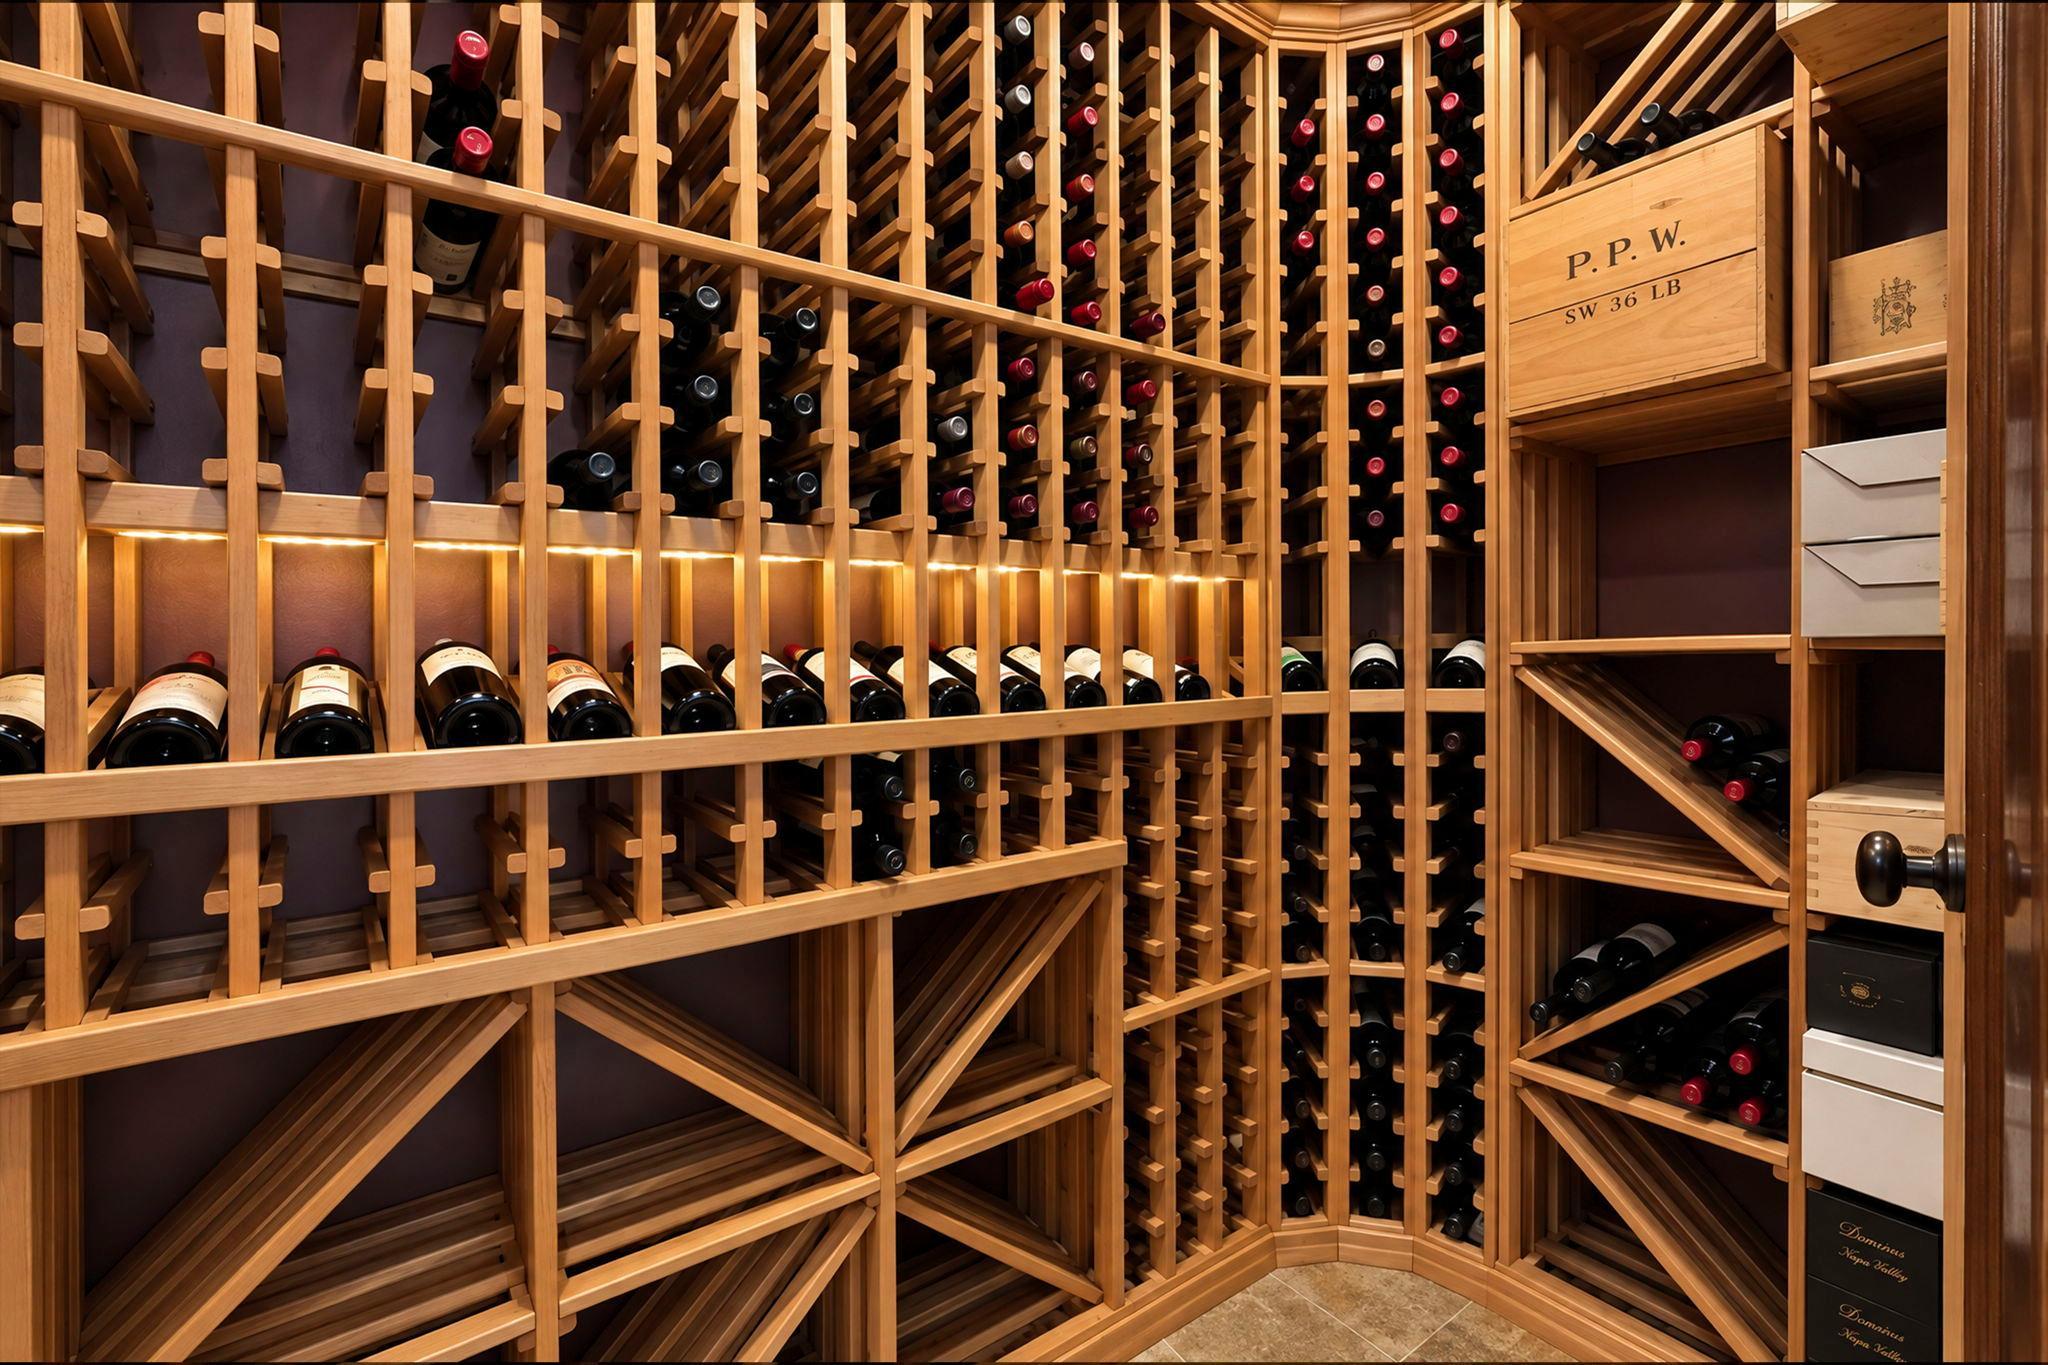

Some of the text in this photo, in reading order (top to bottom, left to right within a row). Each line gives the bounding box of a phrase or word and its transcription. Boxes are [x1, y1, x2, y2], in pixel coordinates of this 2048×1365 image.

[1565, 278, 1682, 325] SW 36 LB
[1839, 1220, 1905, 1259] Dominus
[1838, 1246, 1908, 1283] Napa Valley
[1838, 1327, 1871, 1350] Napa
[1839, 1303, 1905, 1343] Dominus
